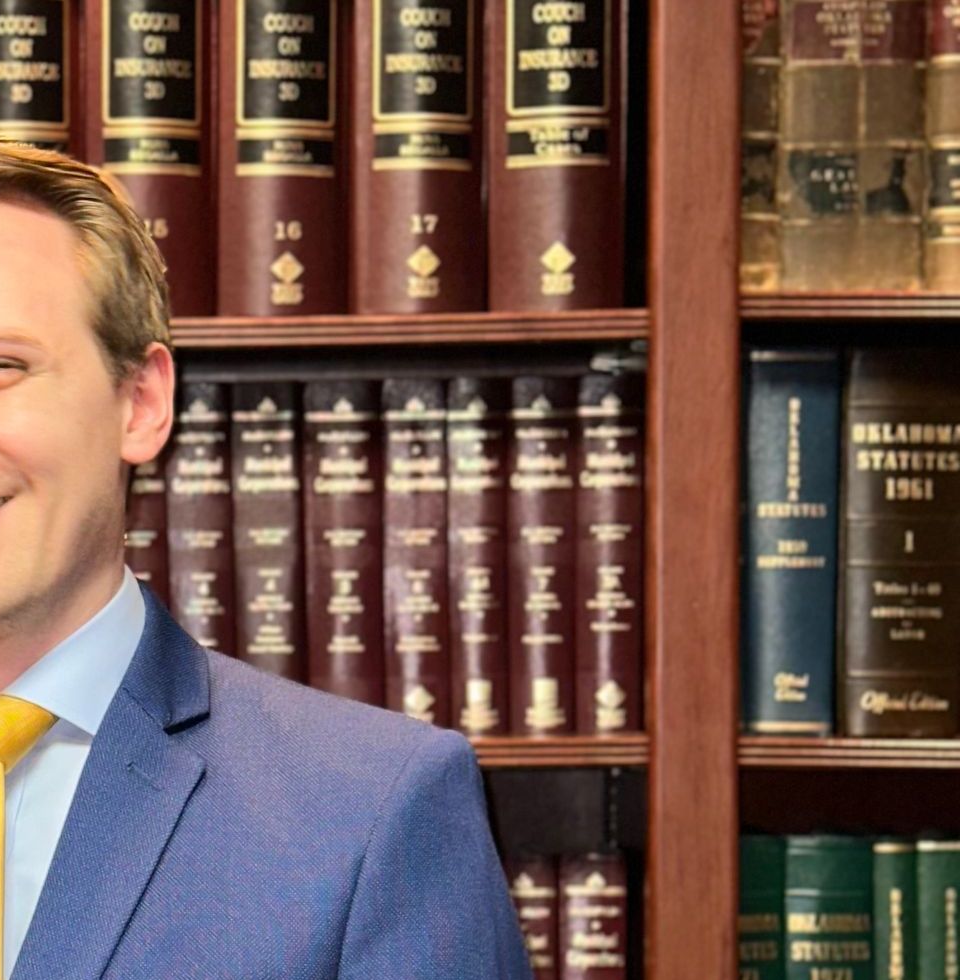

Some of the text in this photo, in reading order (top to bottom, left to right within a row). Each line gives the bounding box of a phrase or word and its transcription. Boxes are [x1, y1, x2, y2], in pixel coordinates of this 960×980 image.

[129, 12, 179, 31] COUCH
[400, 8, 450, 28] COUCH
[533, 3, 584, 23] COUCH
[264, 13, 313, 33] COUCH
[143, 35, 166, 53] ON
[414, 31, 437, 49] ON
[548, 26, 570, 45] ON
[9, 39, 33, 58] ON
[278, 37, 300, 55] ON
[274, 221, 302, 240] 16
[410, 214, 438, 233] 17
[852, 423, 960, 444] OKLAHOMA
[856, 450, 960, 471] STATUTES
[885, 478, 933, 499] 1961
